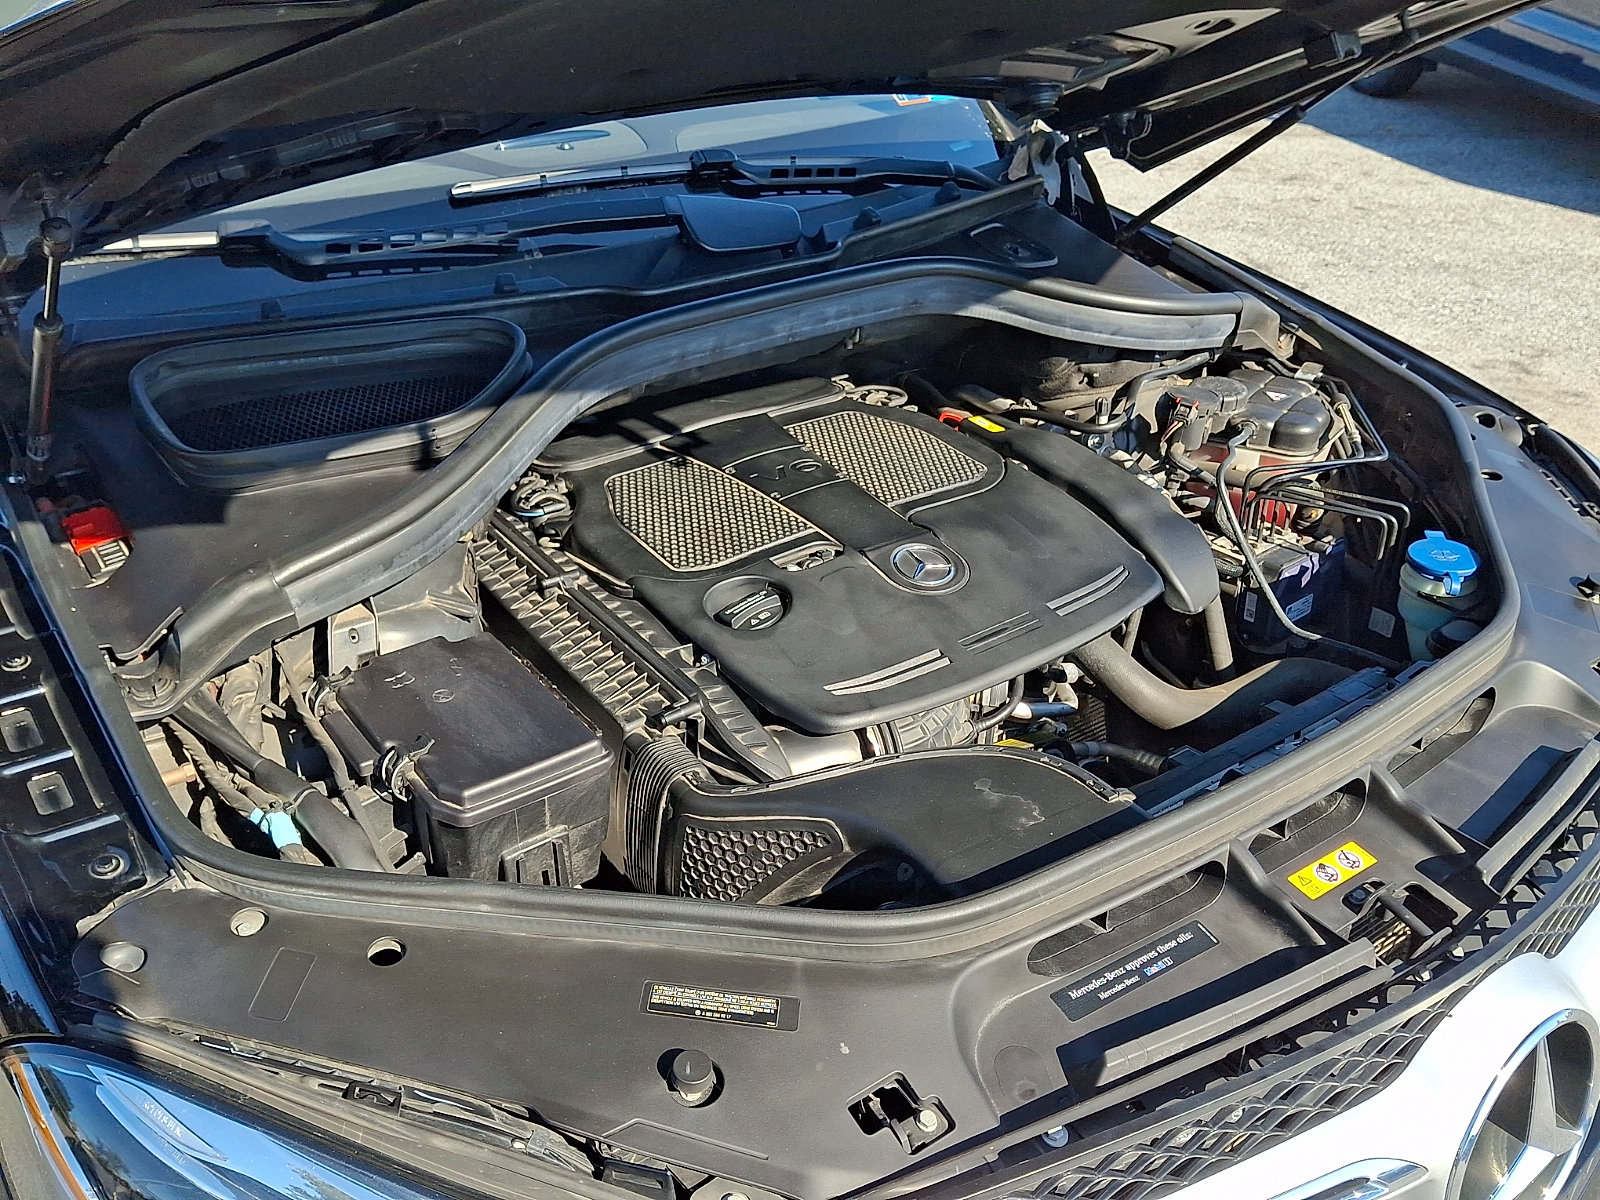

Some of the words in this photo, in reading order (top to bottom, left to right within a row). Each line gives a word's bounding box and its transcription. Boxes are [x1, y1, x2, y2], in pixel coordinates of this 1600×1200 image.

[1068, 967, 1127, 1000] Mercedes-Benz
[1125, 951, 1159, 976] approves
[1156, 940, 1178, 960] these
[1098, 975, 1140, 1000] Mercedes-Benz
